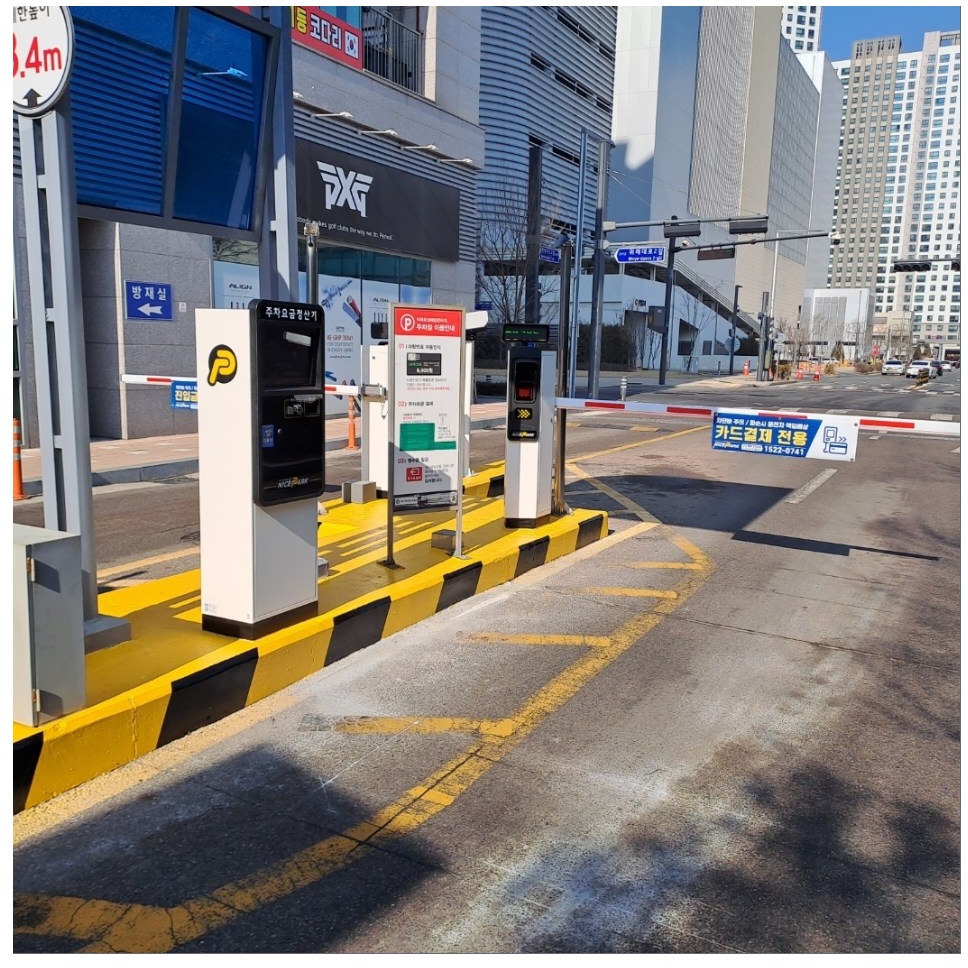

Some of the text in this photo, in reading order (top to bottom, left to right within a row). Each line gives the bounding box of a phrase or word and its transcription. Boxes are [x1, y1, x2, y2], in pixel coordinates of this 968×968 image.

[310, 13, 342, 50] 코다리
[316, 160, 374, 218] PXG
[328, 223, 337, 231] golf
[337, 224, 349, 233] clubs
[265, 306, 318, 322] 주차요금정산기
[416, 323, 456, 332] 주차장 이용안내
[714, 424, 809, 447] 카드결제 전용
[764, 444, 805, 456] 1522-0741
